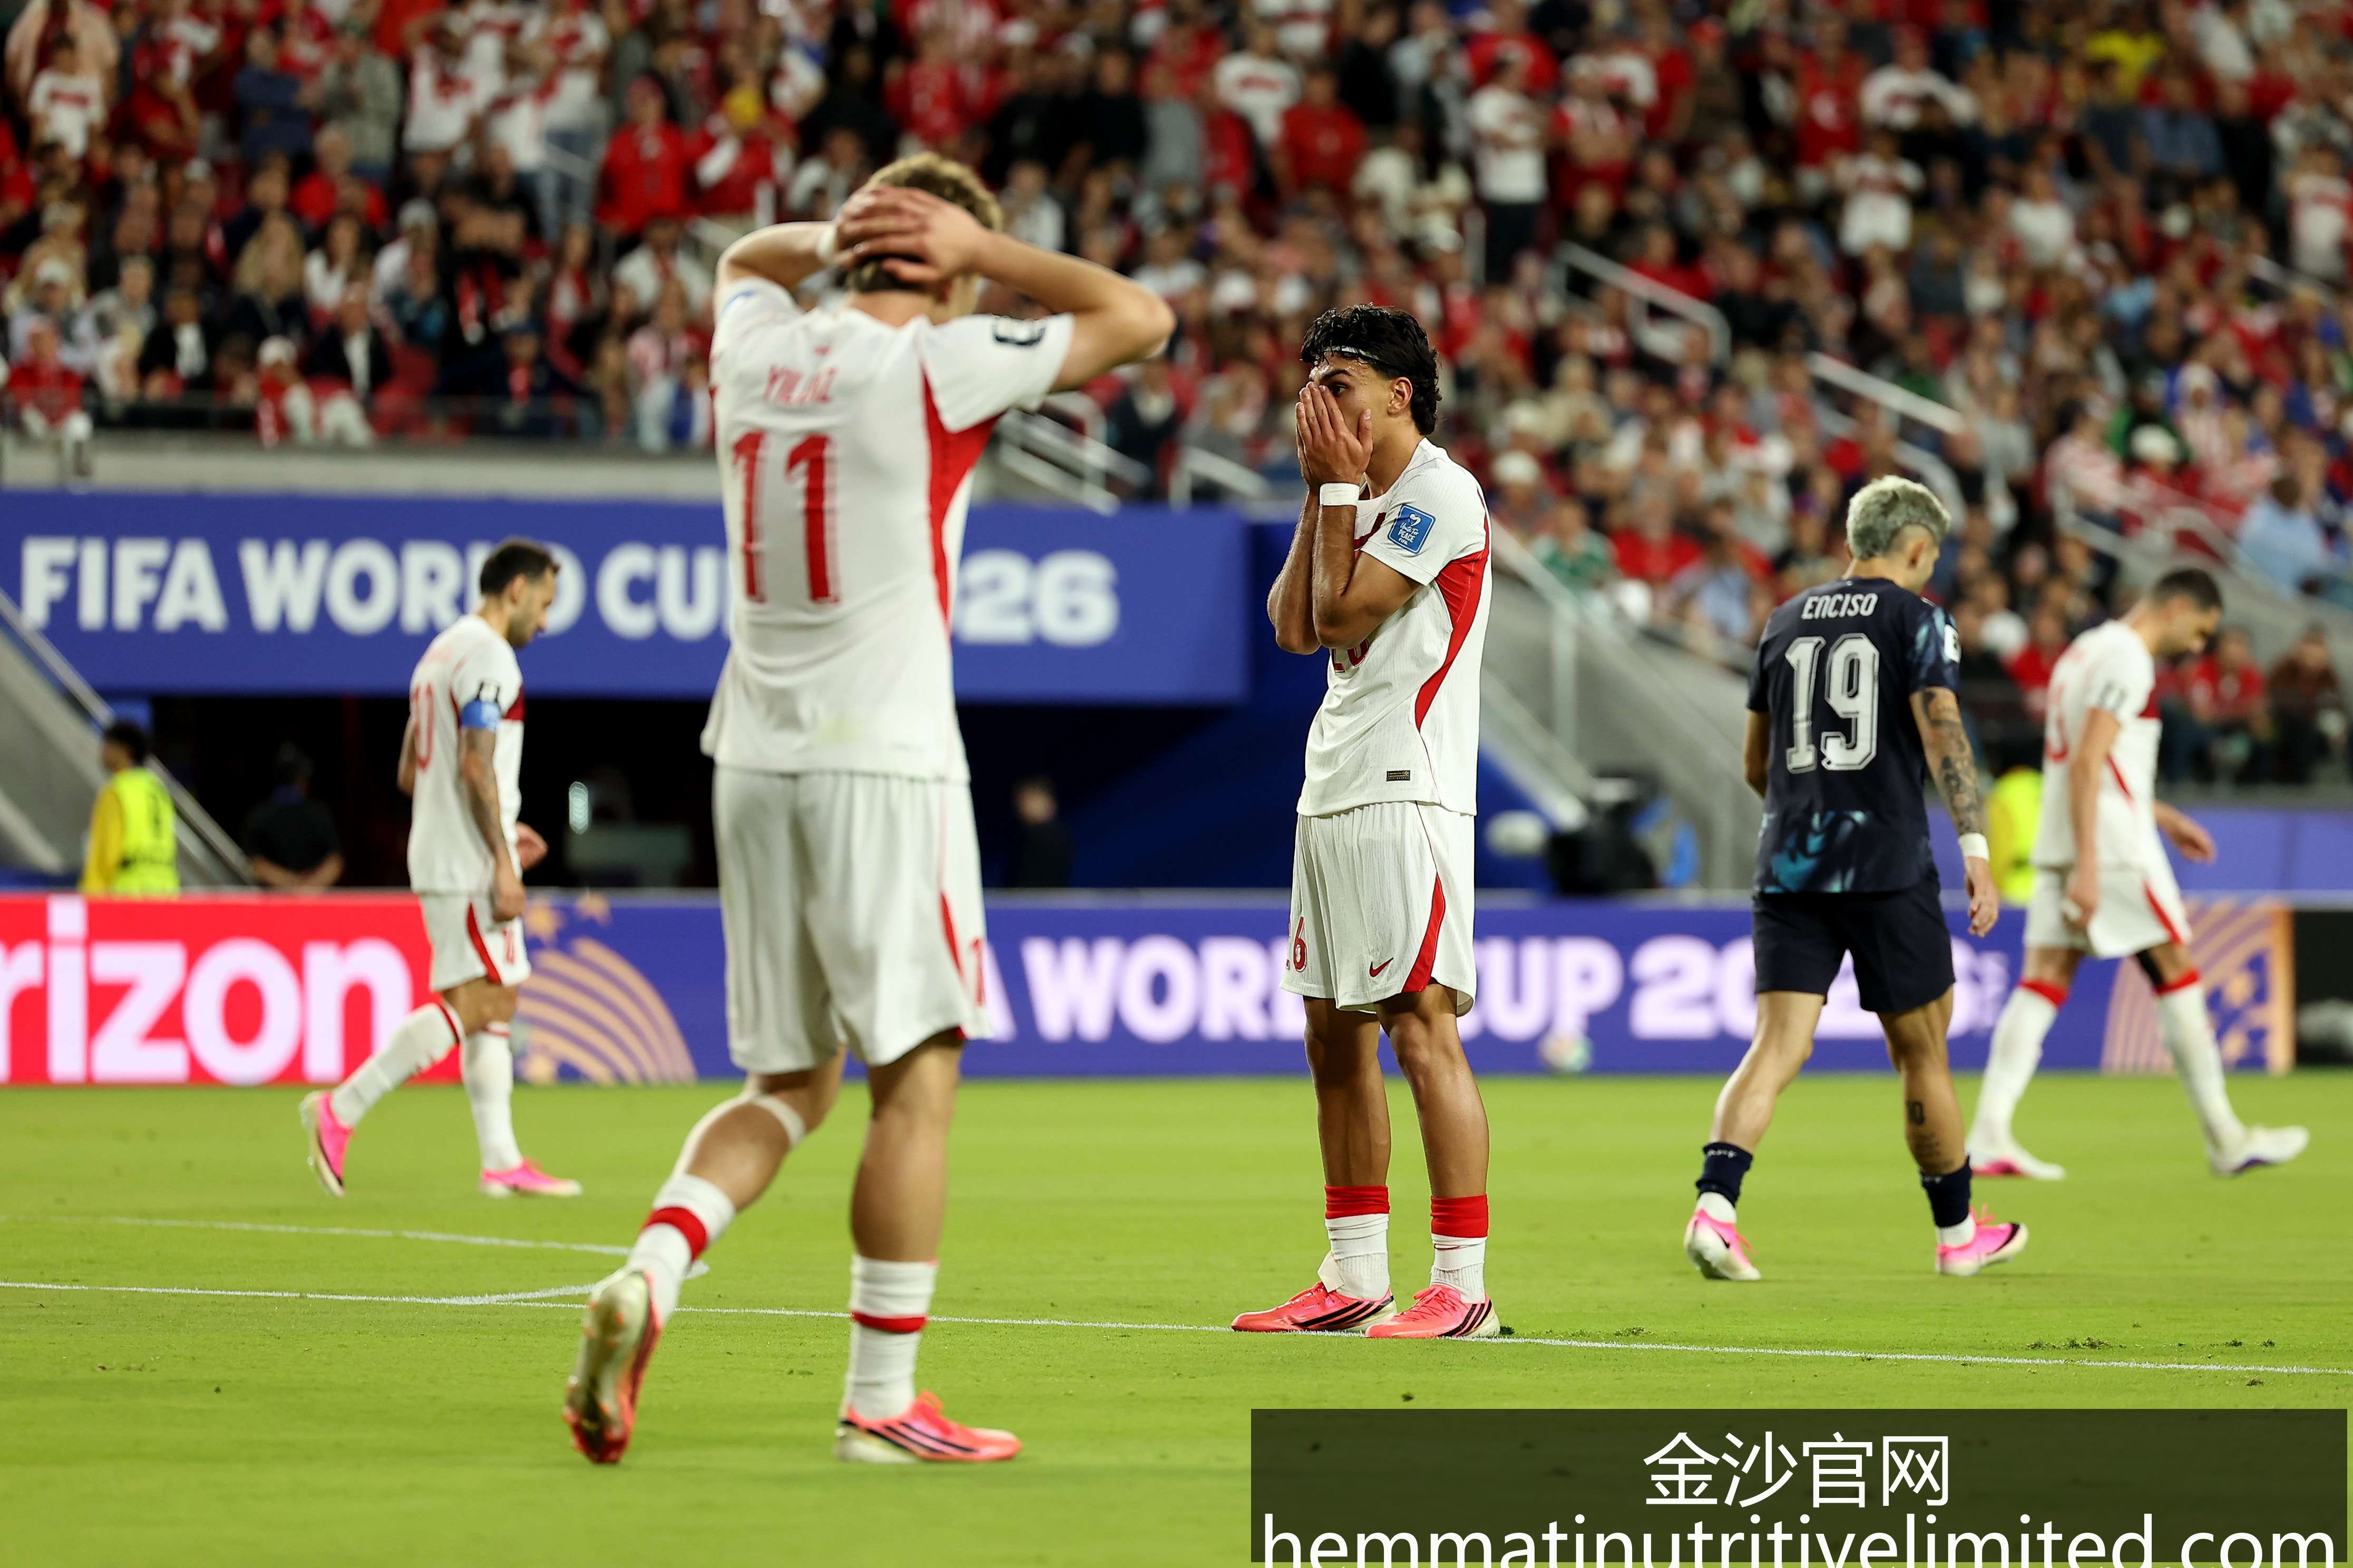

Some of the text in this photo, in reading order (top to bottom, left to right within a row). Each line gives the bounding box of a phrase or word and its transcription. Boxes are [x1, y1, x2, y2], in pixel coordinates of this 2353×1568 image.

[733, 431, 839, 604] 11
[1398, 529, 1415, 543] PEACE
[21, 536, 229, 632] FIFA
[595, 542, 730, 642] CU
[953, 549, 1121, 648] 26
[1801, 593, 1878, 620] ENCISO
[1785, 632, 1880, 774] 19
[1022, 935, 1306, 1042] WORL
[1465, 934, 1623, 1042] UP
[1286, 916, 1308, 973] 6
